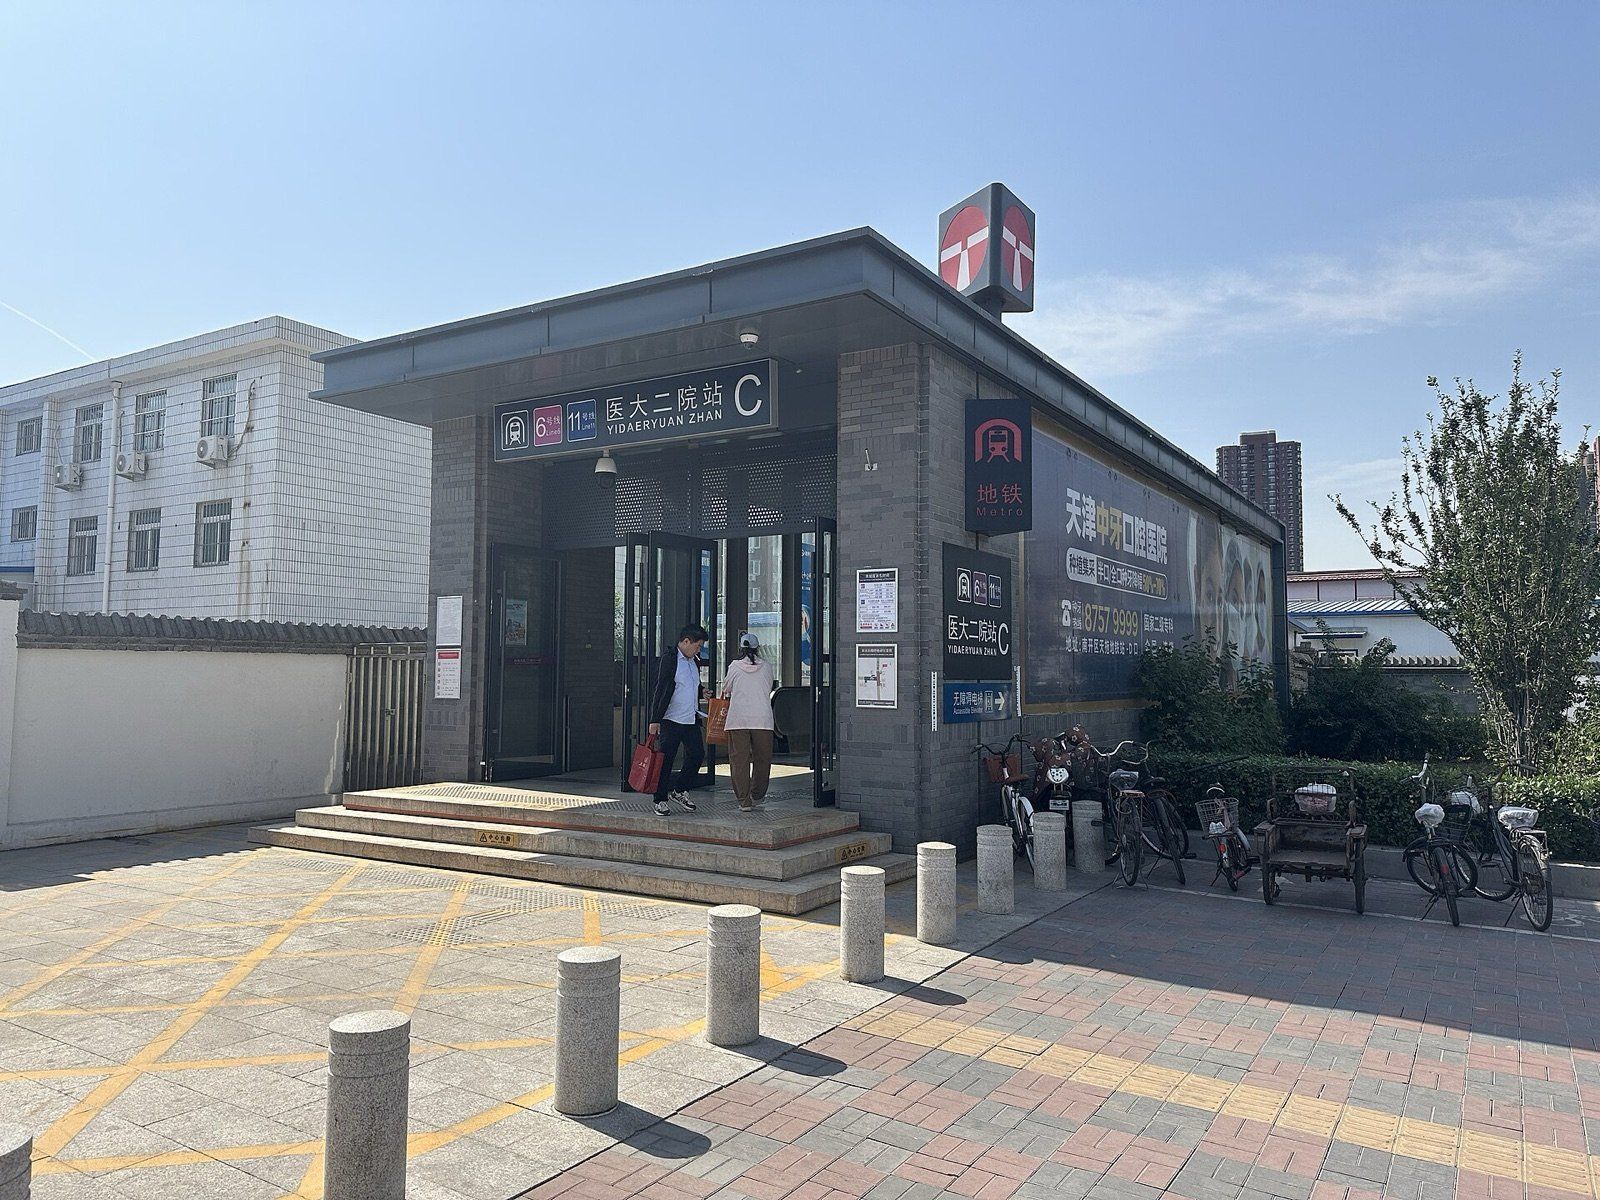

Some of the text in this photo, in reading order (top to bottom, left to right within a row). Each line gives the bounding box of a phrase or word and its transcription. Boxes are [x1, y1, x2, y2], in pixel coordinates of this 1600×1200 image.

[607, 373, 763, 421] 医大二院站 C
[536, 417, 546, 437] 6
[568, 411, 581, 431] 11
[607, 408, 723, 435] YIDAERYUAN ZHAN
[977, 483, 1022, 504] 地铁
[976, 506, 1023, 517] Metro
[1065, 488, 1168, 565] 天津中牙口腔医院
[974, 579, 980, 597] 6
[989, 583, 996, 599] 11
[1084, 603, 1110, 634] 8757
[1113, 608, 1138, 637] 9999
[948, 615, 1009, 656] 医大二院站 C
[947, 645, 997, 656] YIDAERYUAN ZHAN
